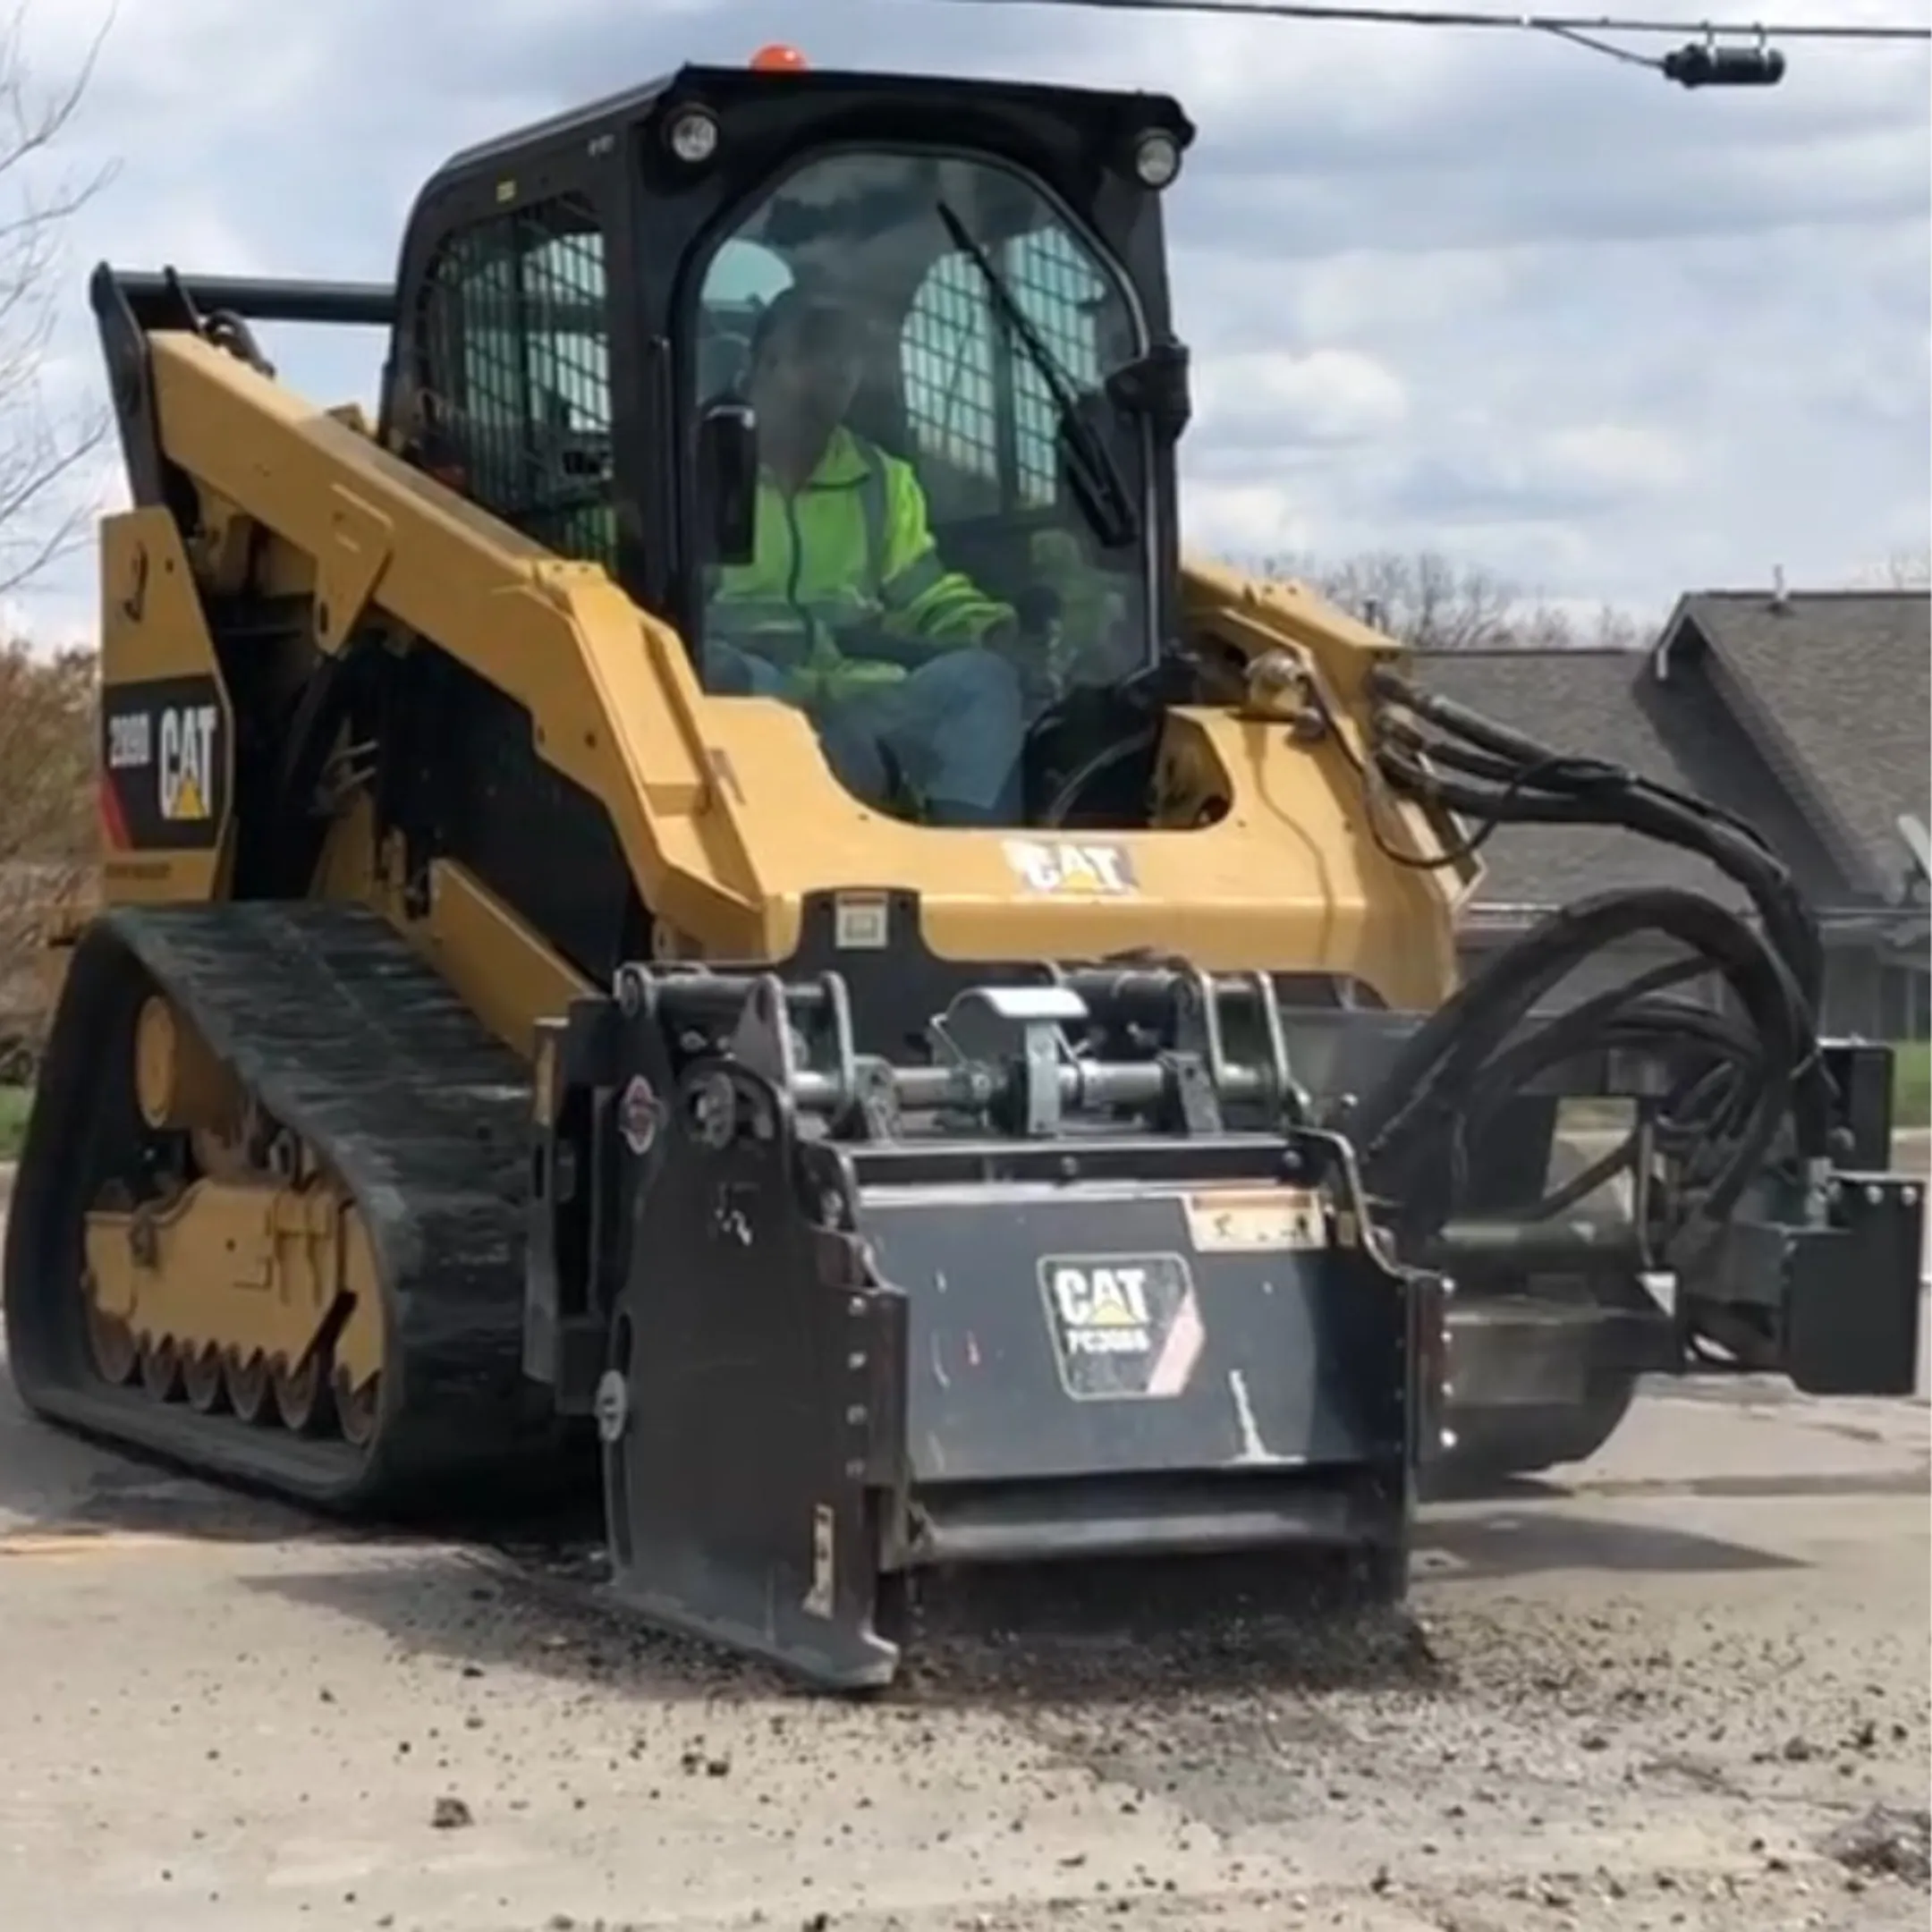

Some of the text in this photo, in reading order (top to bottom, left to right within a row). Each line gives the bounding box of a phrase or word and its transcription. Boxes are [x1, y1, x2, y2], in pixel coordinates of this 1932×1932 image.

[158, 707, 216, 820] CAT
[1016, 843, 1124, 891] CAT
[1055, 1268, 1149, 1325] CAT
